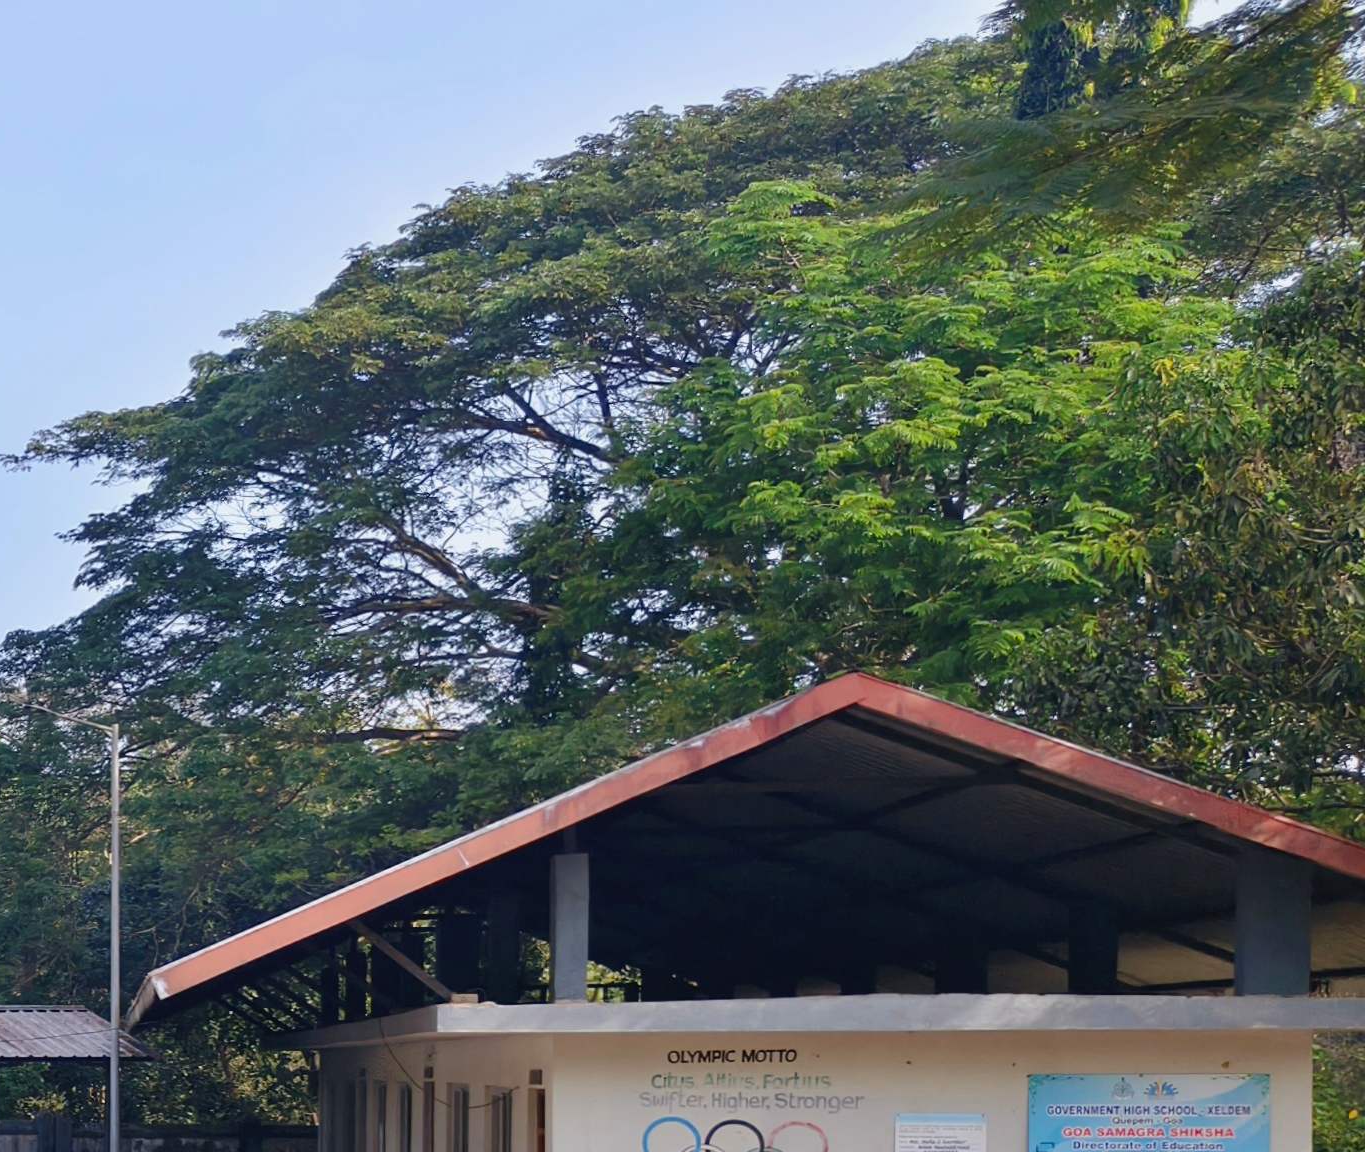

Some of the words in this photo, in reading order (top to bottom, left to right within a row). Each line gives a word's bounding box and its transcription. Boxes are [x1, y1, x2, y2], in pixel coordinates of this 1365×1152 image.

[667, 1050, 736, 1064] OLYMPIC
[741, 1049, 797, 1063] MOTTO
[775, 1092, 865, 1114] Stronger
[1047, 1105, 1120, 1116] GOVERNMENT
[1123, 1105, 1150, 1116] HIGH
[1208, 1105, 1251, 1116] XELDEM
[1112, 1117, 1154, 1126] Quepem
[1162, 1117, 1183, 1125] Goa
[1063, 1128, 1092, 1137] GOA
[1097, 1128, 1164, 1137] SAMAGRA
[1171, 1128, 1234, 1137] SHIKSHA
[1073, 1141, 1141, 1150] Directorate
[1145, 1141, 1157, 1150] of
[1162, 1141, 1223, 1151] Education
